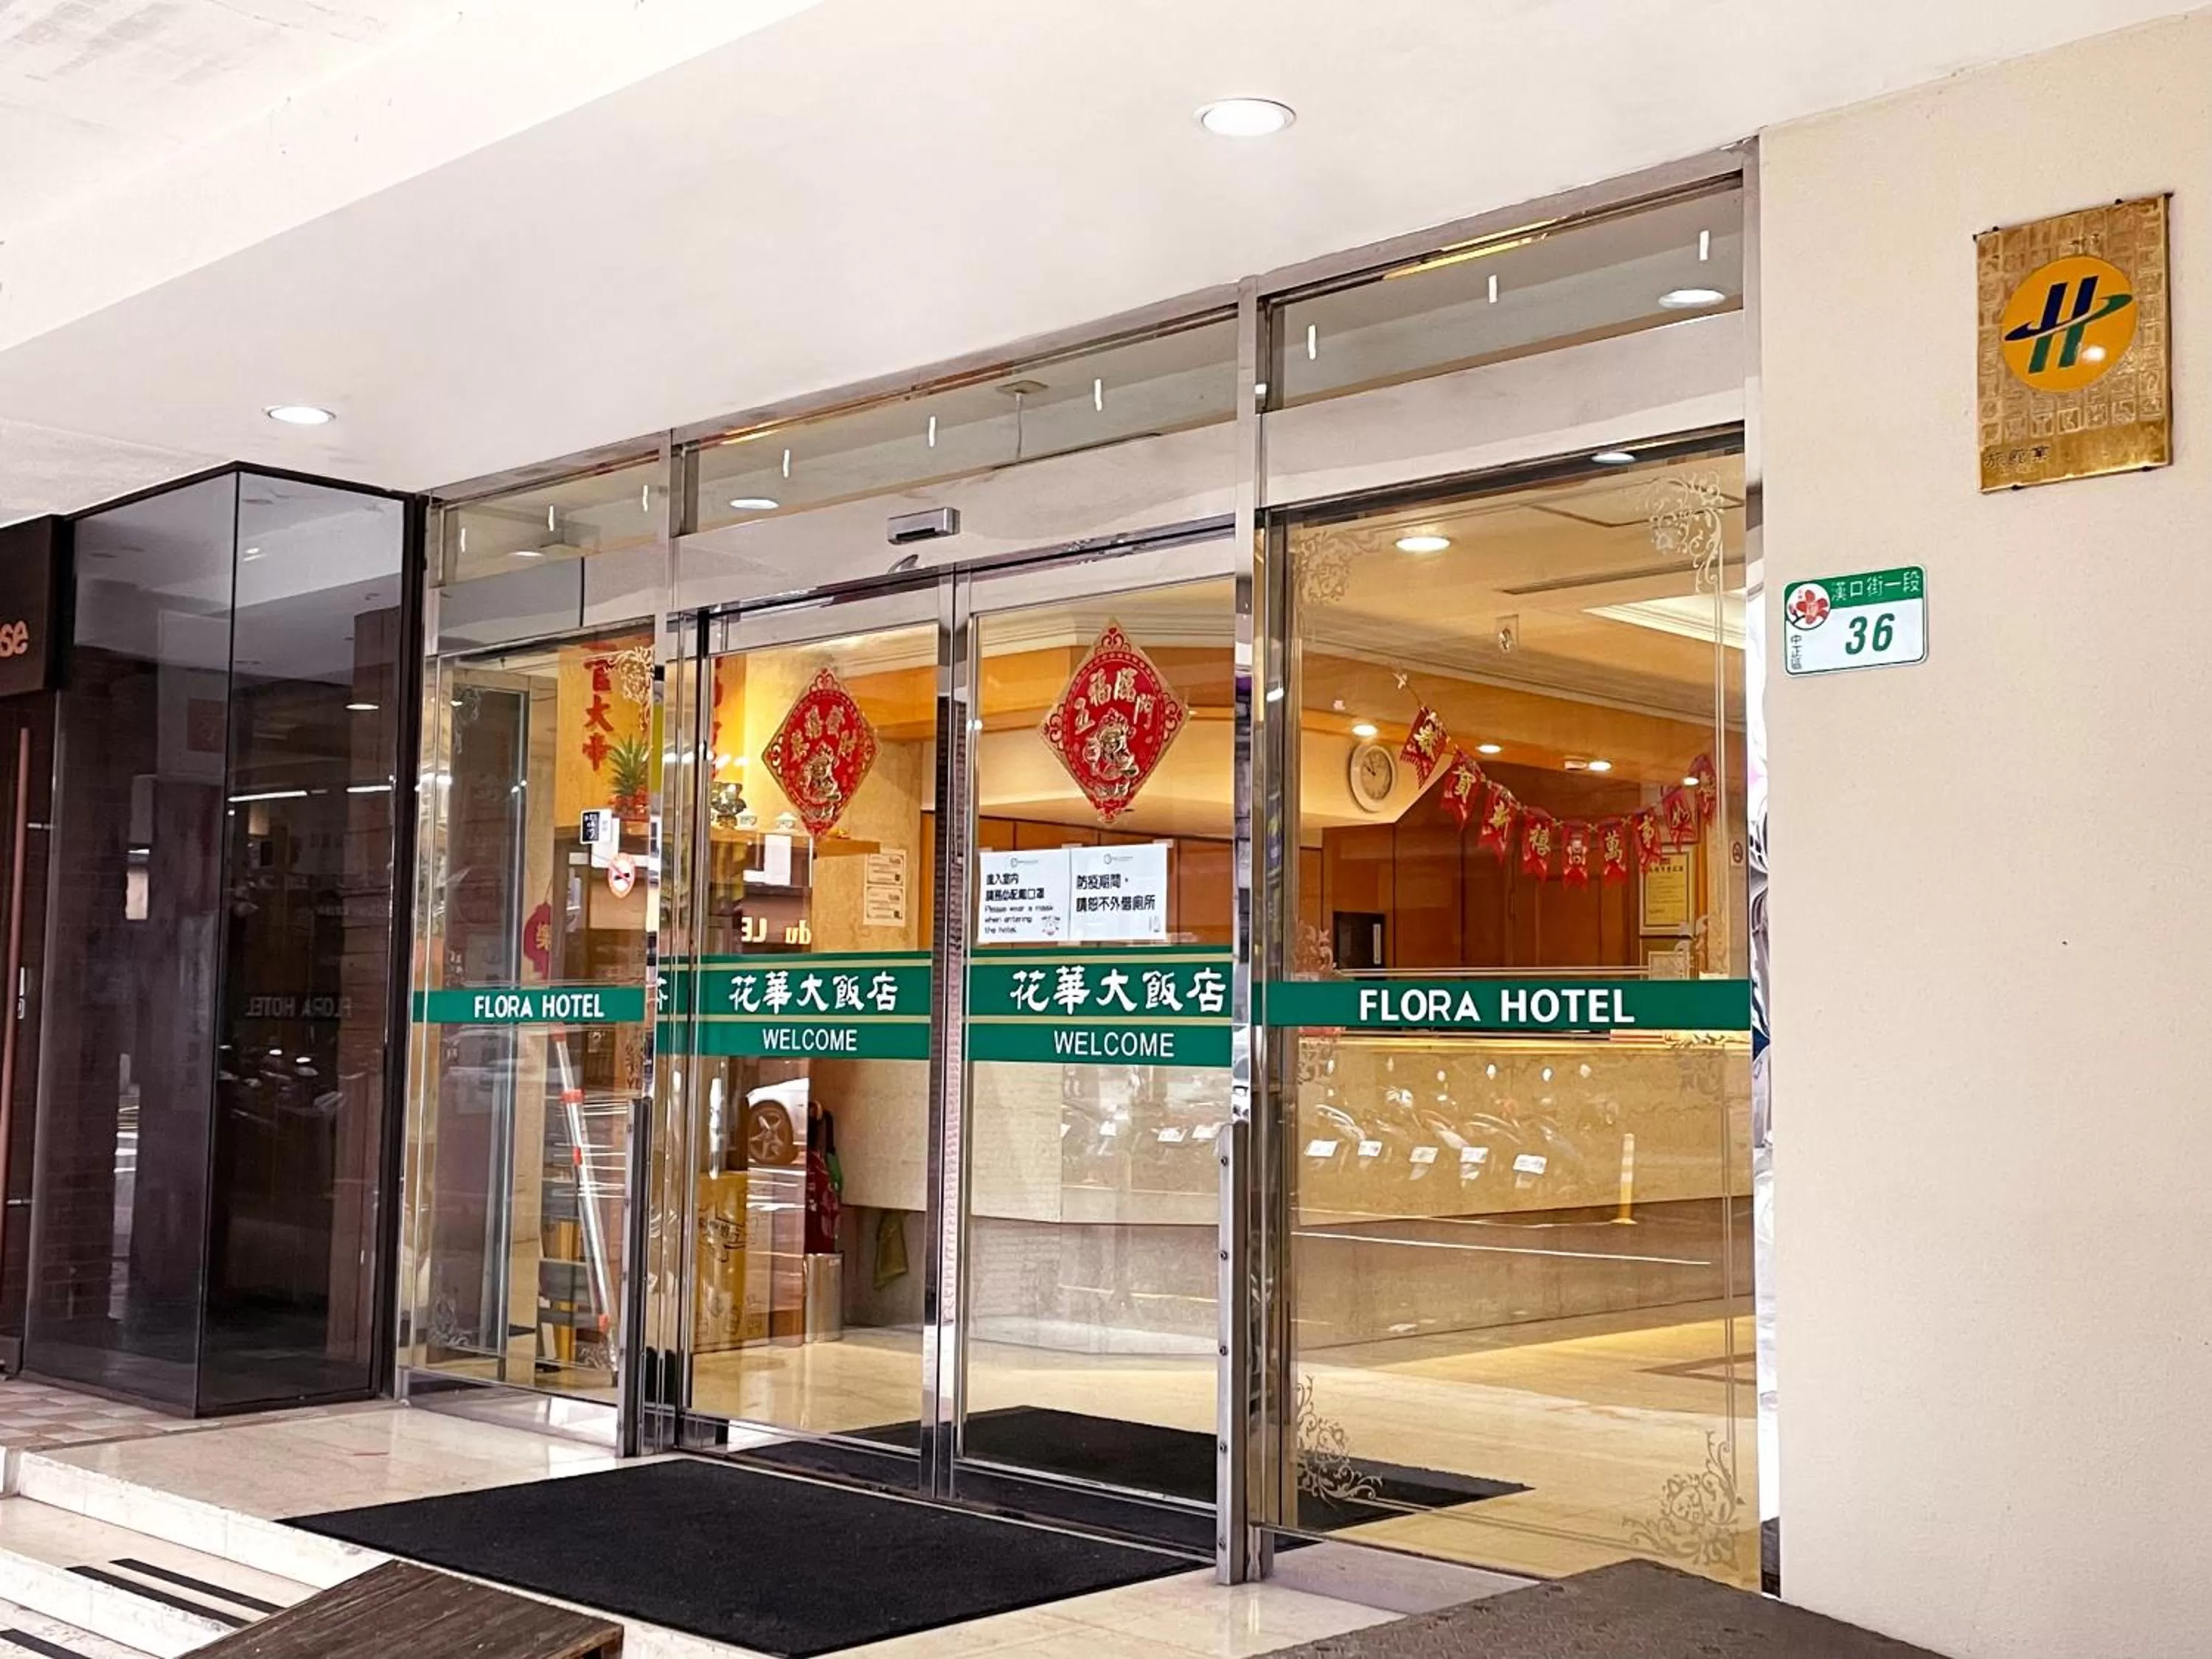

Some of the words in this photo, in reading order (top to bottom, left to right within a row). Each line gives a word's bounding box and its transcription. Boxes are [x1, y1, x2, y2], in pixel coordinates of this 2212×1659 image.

[1831, 571, 1920, 602] 漢口街一段
[1845, 613, 1896, 655] 36
[984, 905, 1006, 913] Please
[728, 970, 898, 1015] 花華大飯店
[1009, 965, 1227, 1015] 花華大飯店
[474, 995, 532, 1018] FLORA
[542, 994, 605, 1018] HOTEL
[1359, 989, 1480, 1023] FLORA
[1500, 989, 1635, 1023] HOTEL
[762, 1029, 858, 1051] WELCOME
[1054, 1030, 1175, 1057] WELCOME
